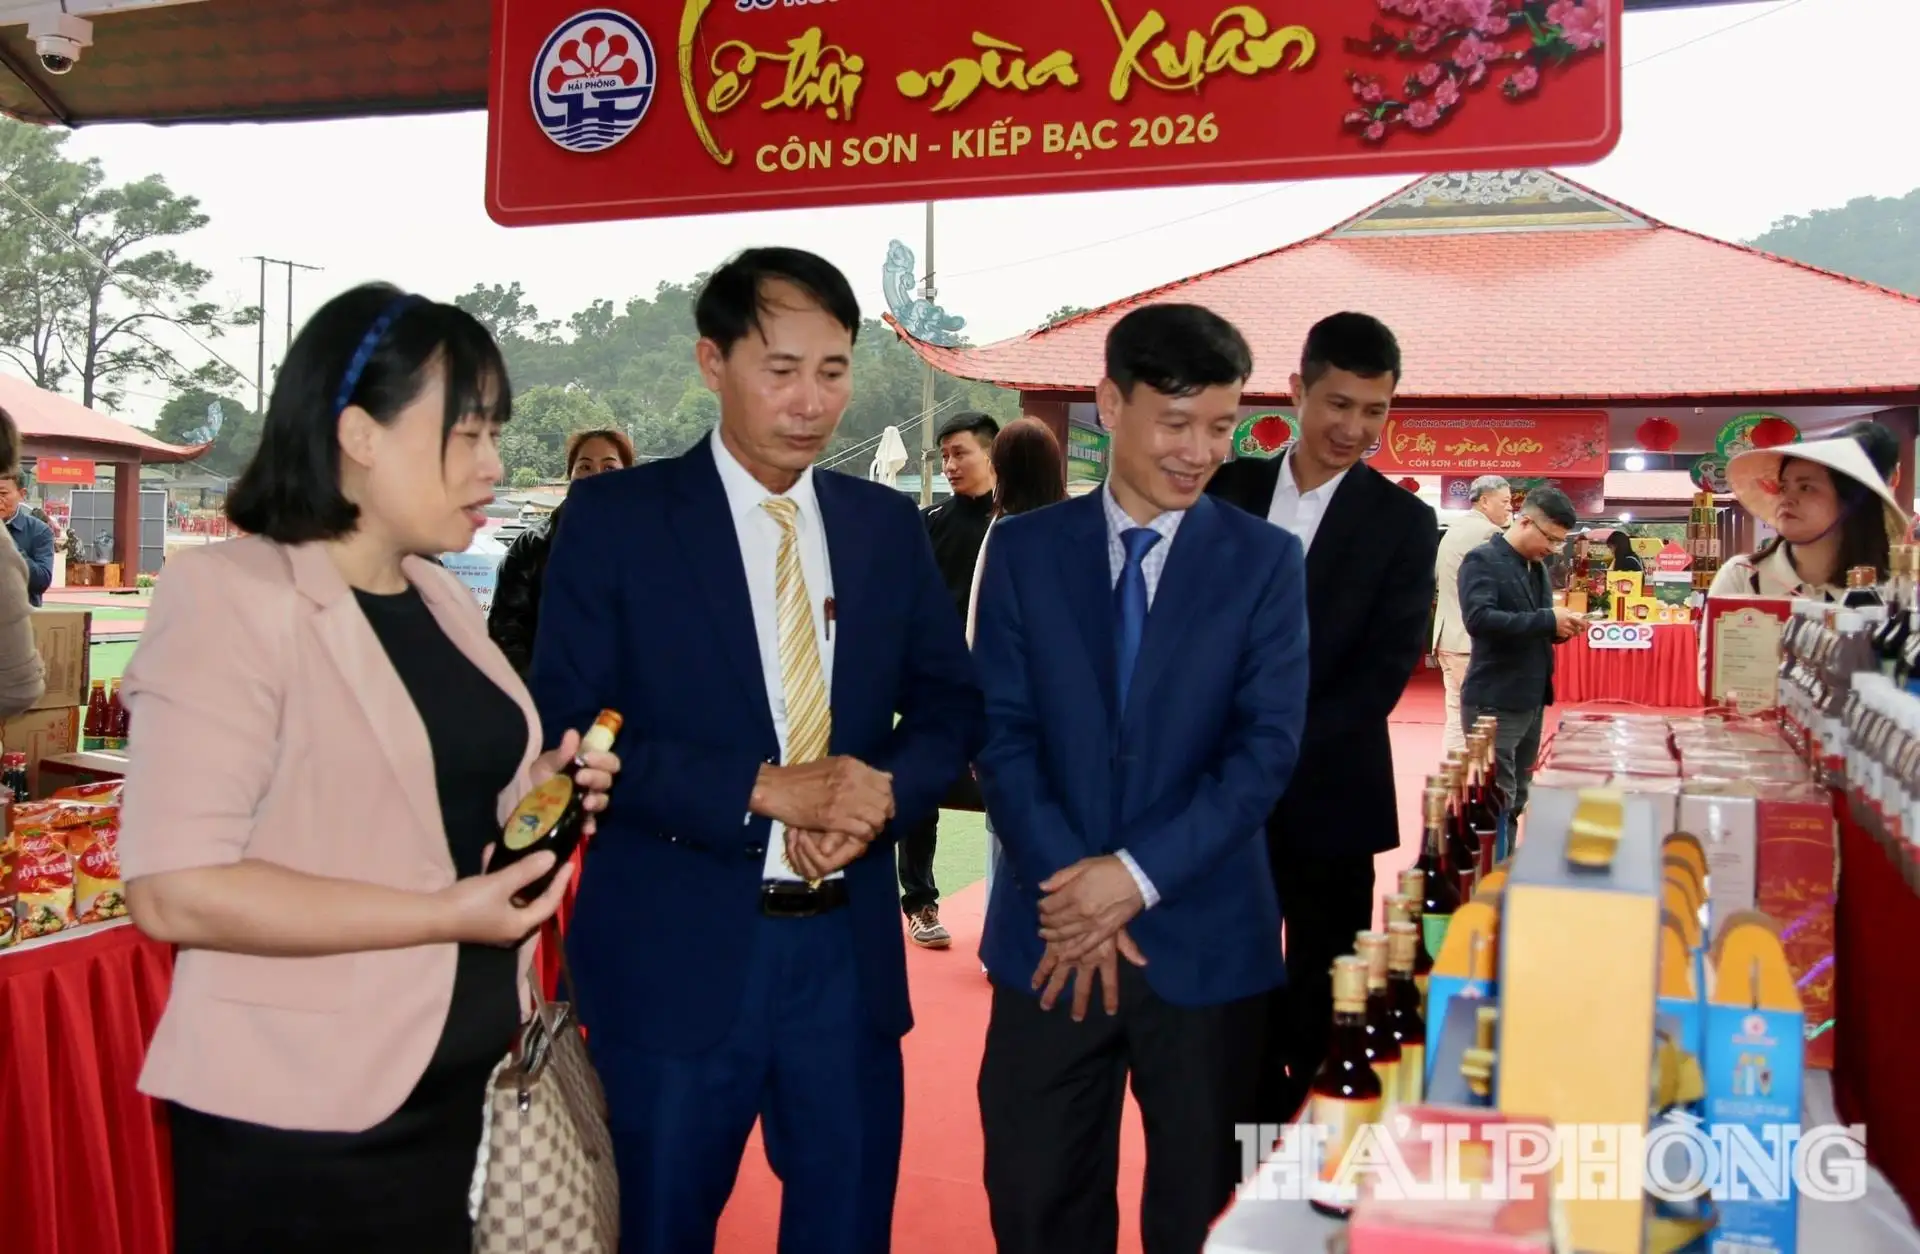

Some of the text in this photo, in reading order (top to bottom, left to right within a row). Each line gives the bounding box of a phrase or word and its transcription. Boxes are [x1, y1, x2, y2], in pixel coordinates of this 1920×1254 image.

[896, 31, 1079, 112] mùa
[1101, 0, 1316, 101] Xuân
[568, 80, 582, 91] HẢI
[756, 136, 832, 172] CÔN
[842, 134, 918, 167] SƠN
[951, 117, 1031, 159] KIẾP
[1042, 120, 1118, 159] BẠC
[1129, 113, 1219, 148] 2026
[1408, 458, 1429, 467] CÔN
[1431, 459, 1450, 468] SƠN
[1459, 458, 1478, 468] KIẾP
[1480, 460, 1499, 469] BẠC
[1500, 460, 1522, 468] 2026
[1591, 627, 1651, 641] OCOP
